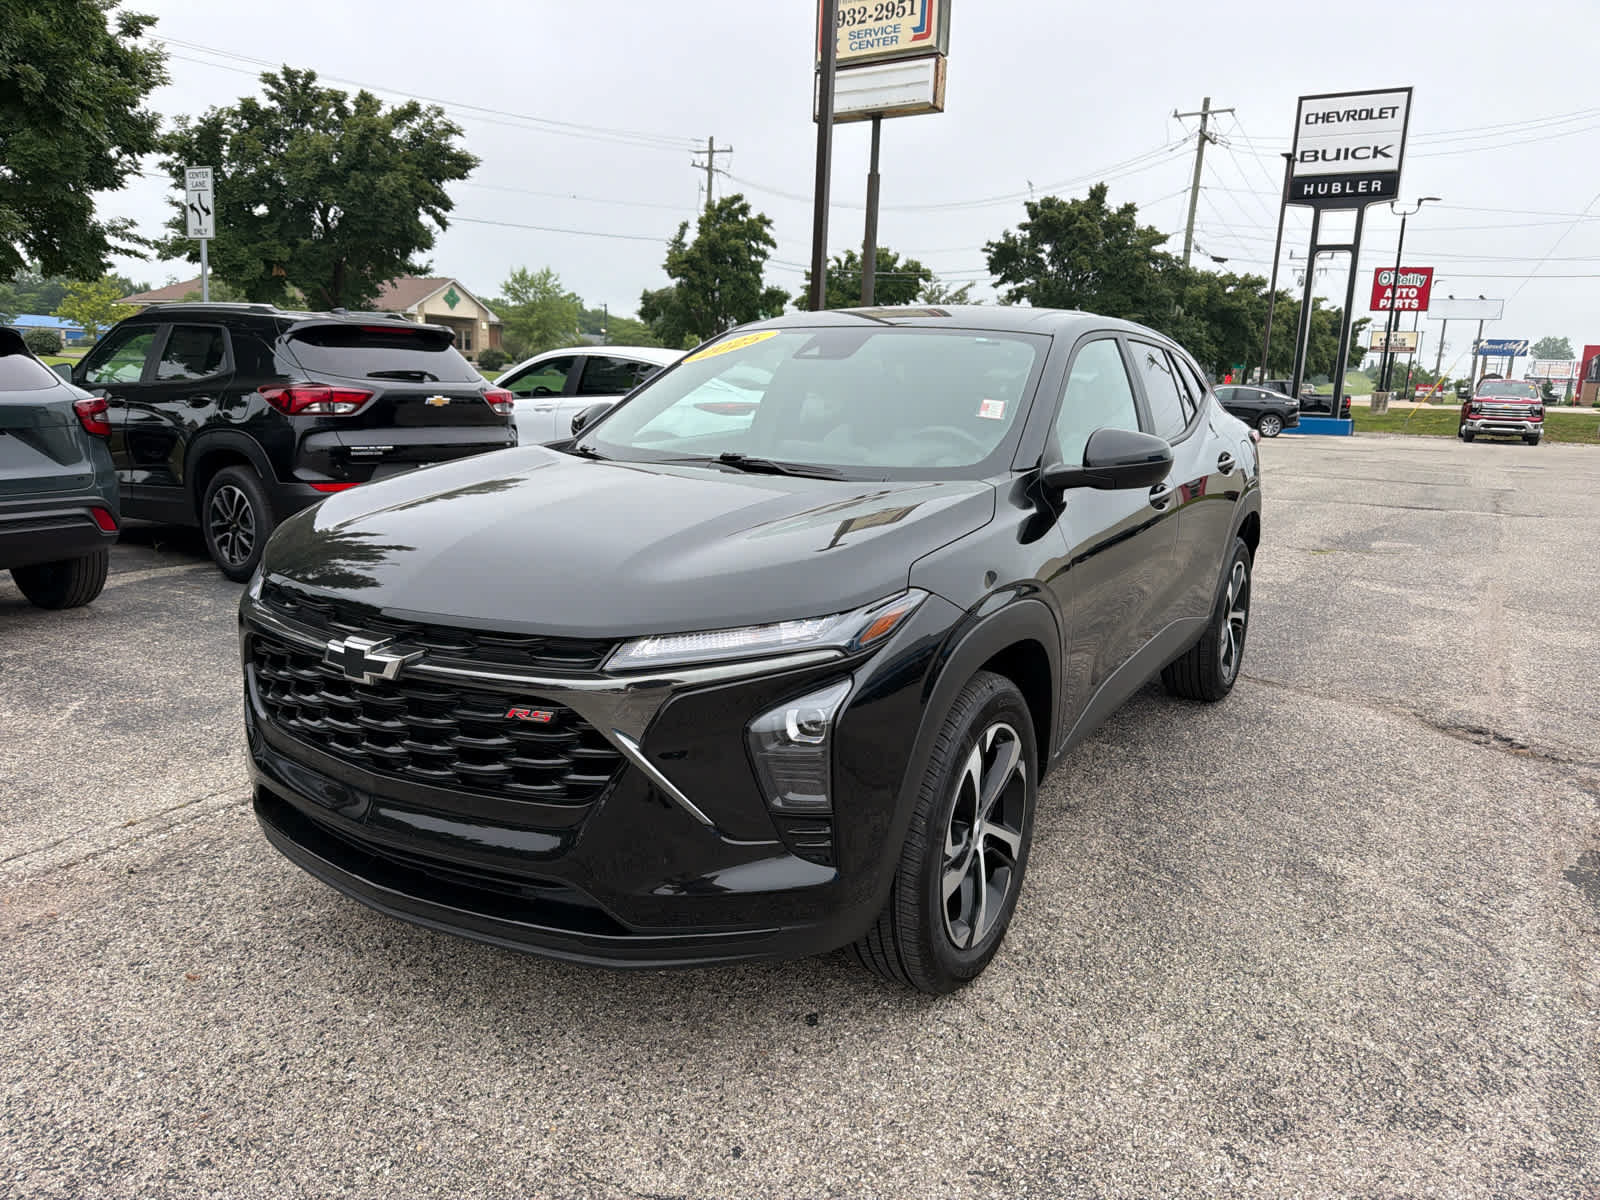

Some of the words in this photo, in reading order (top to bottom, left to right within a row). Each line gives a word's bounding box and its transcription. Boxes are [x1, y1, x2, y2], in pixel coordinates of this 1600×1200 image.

[836, 0, 917, 28] 932-2951
[848, 23, 902, 40] SERVICE
[849, 35, 899, 52] CENTER
[1304, 106, 1400, 125] CHEVROLET
[1299, 144, 1395, 163] BUICK
[191, 180, 207, 188] LANE
[1303, 180, 1382, 195] HUBLER
[504, 707, 554, 723] RS
